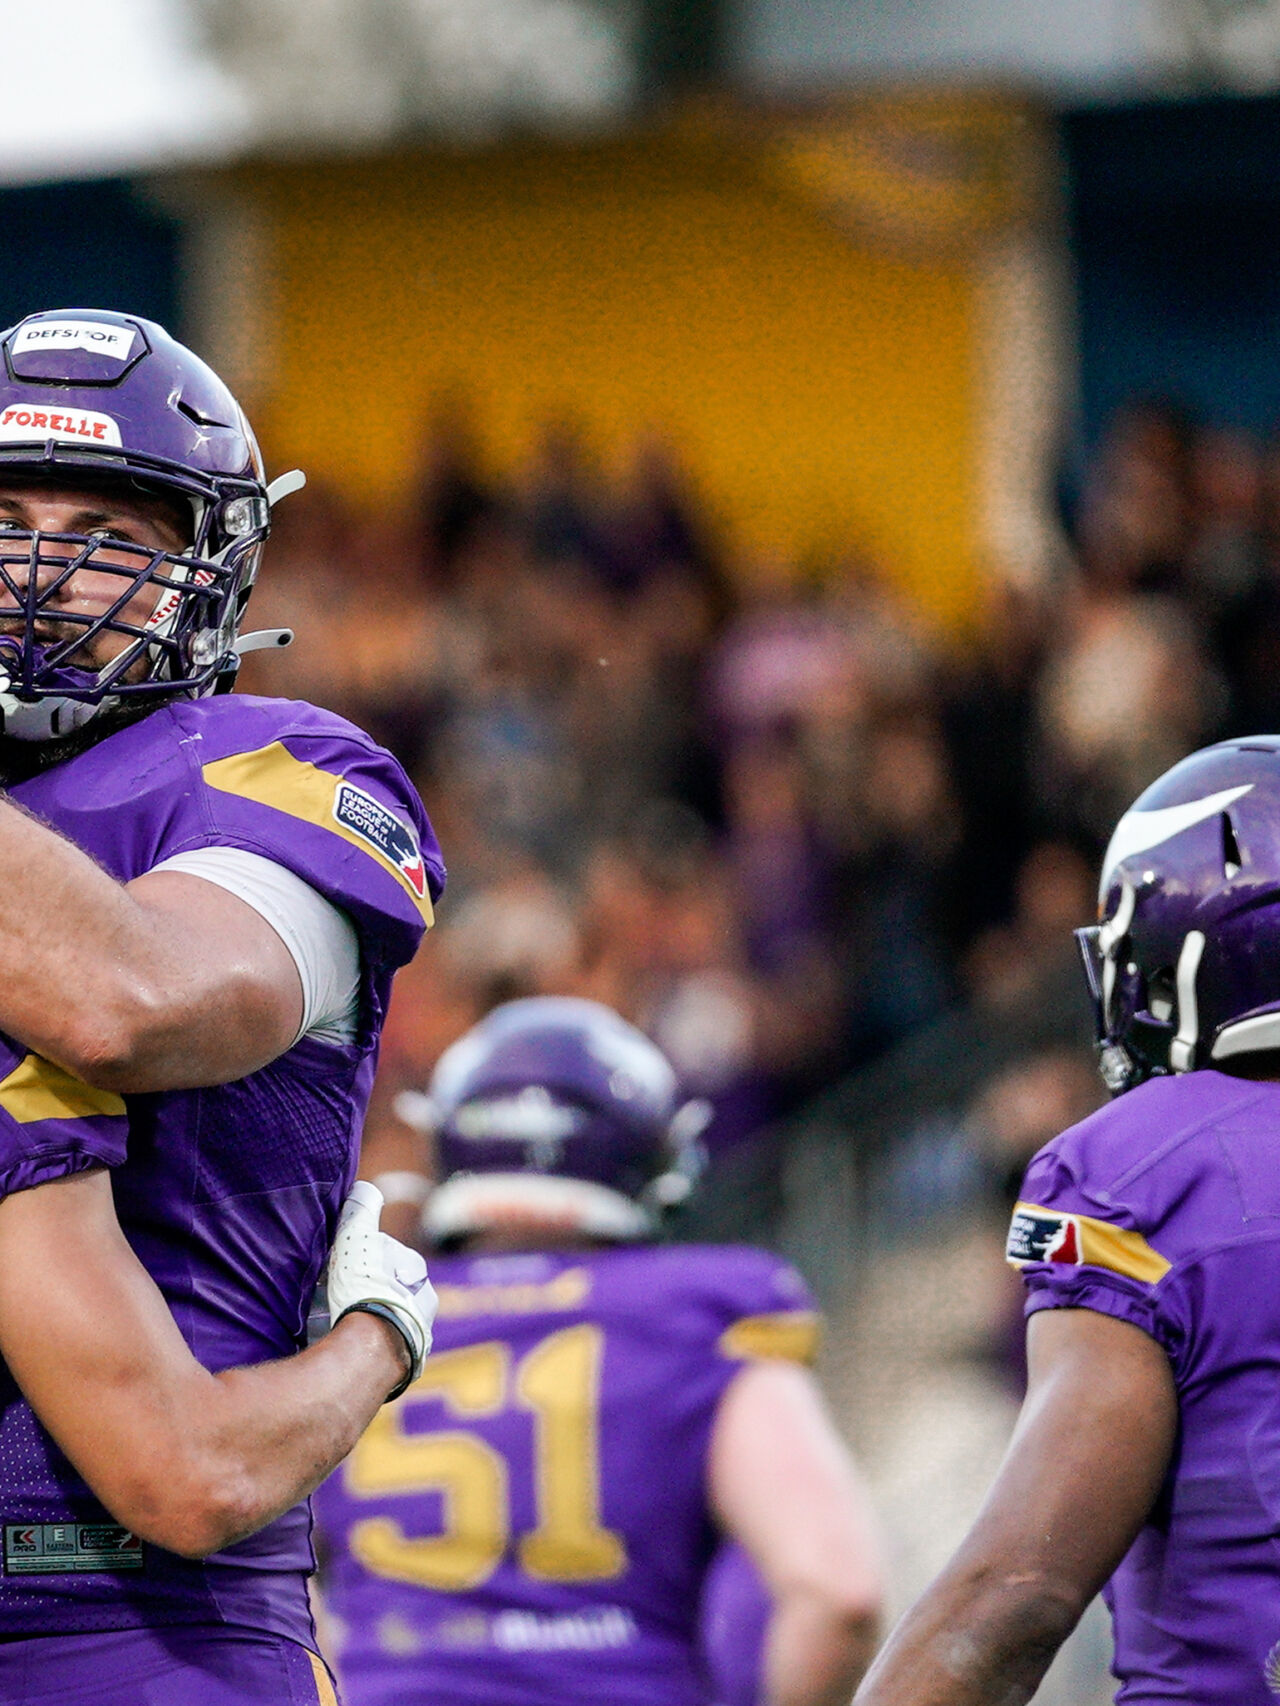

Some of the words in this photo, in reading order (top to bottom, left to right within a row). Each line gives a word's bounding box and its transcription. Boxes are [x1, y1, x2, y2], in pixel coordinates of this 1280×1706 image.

[2, 410, 108, 440] FORELLE
[149, 571, 215, 624] Ridell
[339, 805, 389, 848] FOOTBALL
[342, 797, 382, 828] LEAGUE
[347, 1322, 629, 1594] 51
[13, 1544, 37, 1553] PRO
